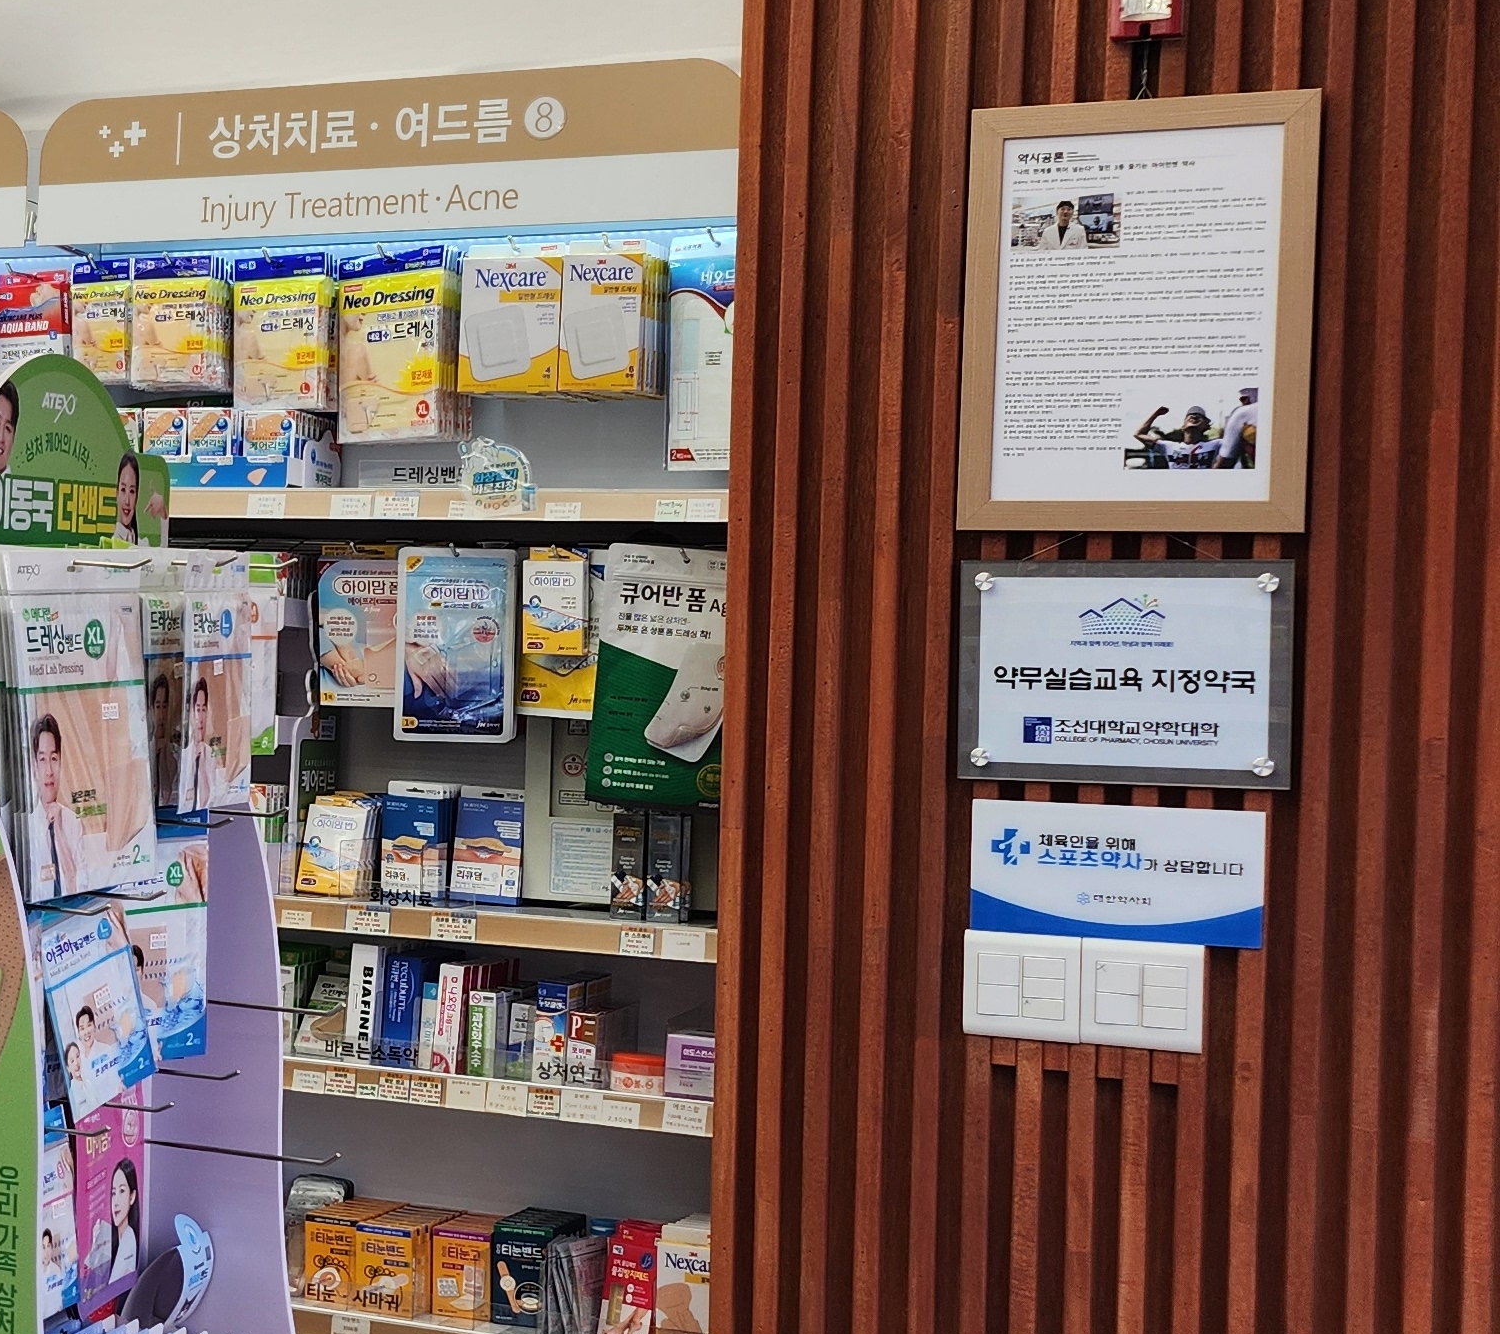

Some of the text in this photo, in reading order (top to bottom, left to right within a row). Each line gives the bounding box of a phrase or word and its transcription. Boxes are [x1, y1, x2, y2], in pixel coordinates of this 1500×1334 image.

[209, 108, 358, 160] 상처치료
[395, 98, 512, 147] 여드름
[202, 184, 519, 230] Injury Treatment Acne
[475, 269, 547, 292] Nexcare
[570, 264, 634, 287] Nexcare
[73, 289, 124, 299] Neo Dressing
[135, 287, 206, 300] Neo Dressing
[240, 291, 316, 306] Neo Dressing
[343, 286, 434, 310] Neo Dressing
[1, 321, 49, 334] AQUA BAND
[281, 318, 314, 330] 드레싱
[392, 320, 434, 340] 드레싱
[25, 436, 43, 463] 상처
[57, 481, 117, 534] 더밴드
[619, 582, 707, 612] 큐어반 폼
[87, 630, 104, 646] XL
[994, 666, 1256, 695] 약무실습교육 지정약국
[1038, 833, 1136, 852] 체육인을 위해
[1164, 859, 1244, 877] 상담합니다
[370, 887, 434, 907] 화상치료
[360, 965, 374, 1045] BIAFINE
[536, 1061, 602, 1084] 상처연고
[365, 1243, 406, 1258] 티눈밴드
[448, 1246, 481, 1262] 티눈고
[501, 1244, 543, 1259] 티눈밴드
[307, 1283, 400, 1313] 티눈 사마귀
